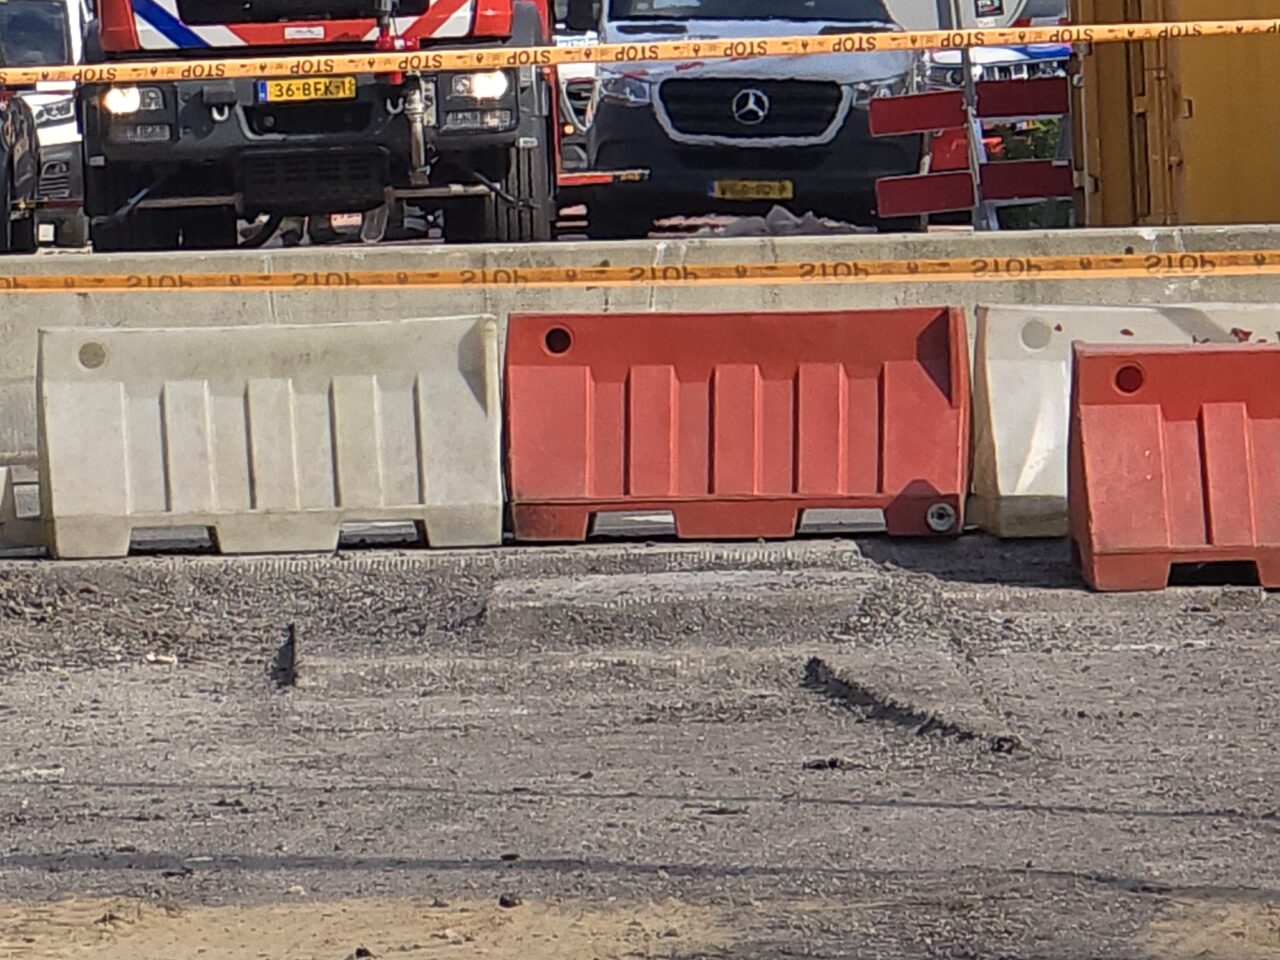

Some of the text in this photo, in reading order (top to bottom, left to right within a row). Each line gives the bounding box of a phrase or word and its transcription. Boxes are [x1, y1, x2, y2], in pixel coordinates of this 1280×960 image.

[941, 31, 985, 47] STOP
[1049, 28, 1094, 43] STOP
[1158, 24, 1202, 39] STOP
[724, 40, 768, 56] STOP
[832, 36, 876, 52] STOP
[507, 50, 551, 65] STOP
[615, 45, 659, 60] STOP
[290, 58, 334, 74] STOP
[398, 54, 442, 69] STOP
[73, 67, 117, 81] STOP
[181, 63, 225, 78] STOP
[273, 79, 348, 98] 36-BFK-1
